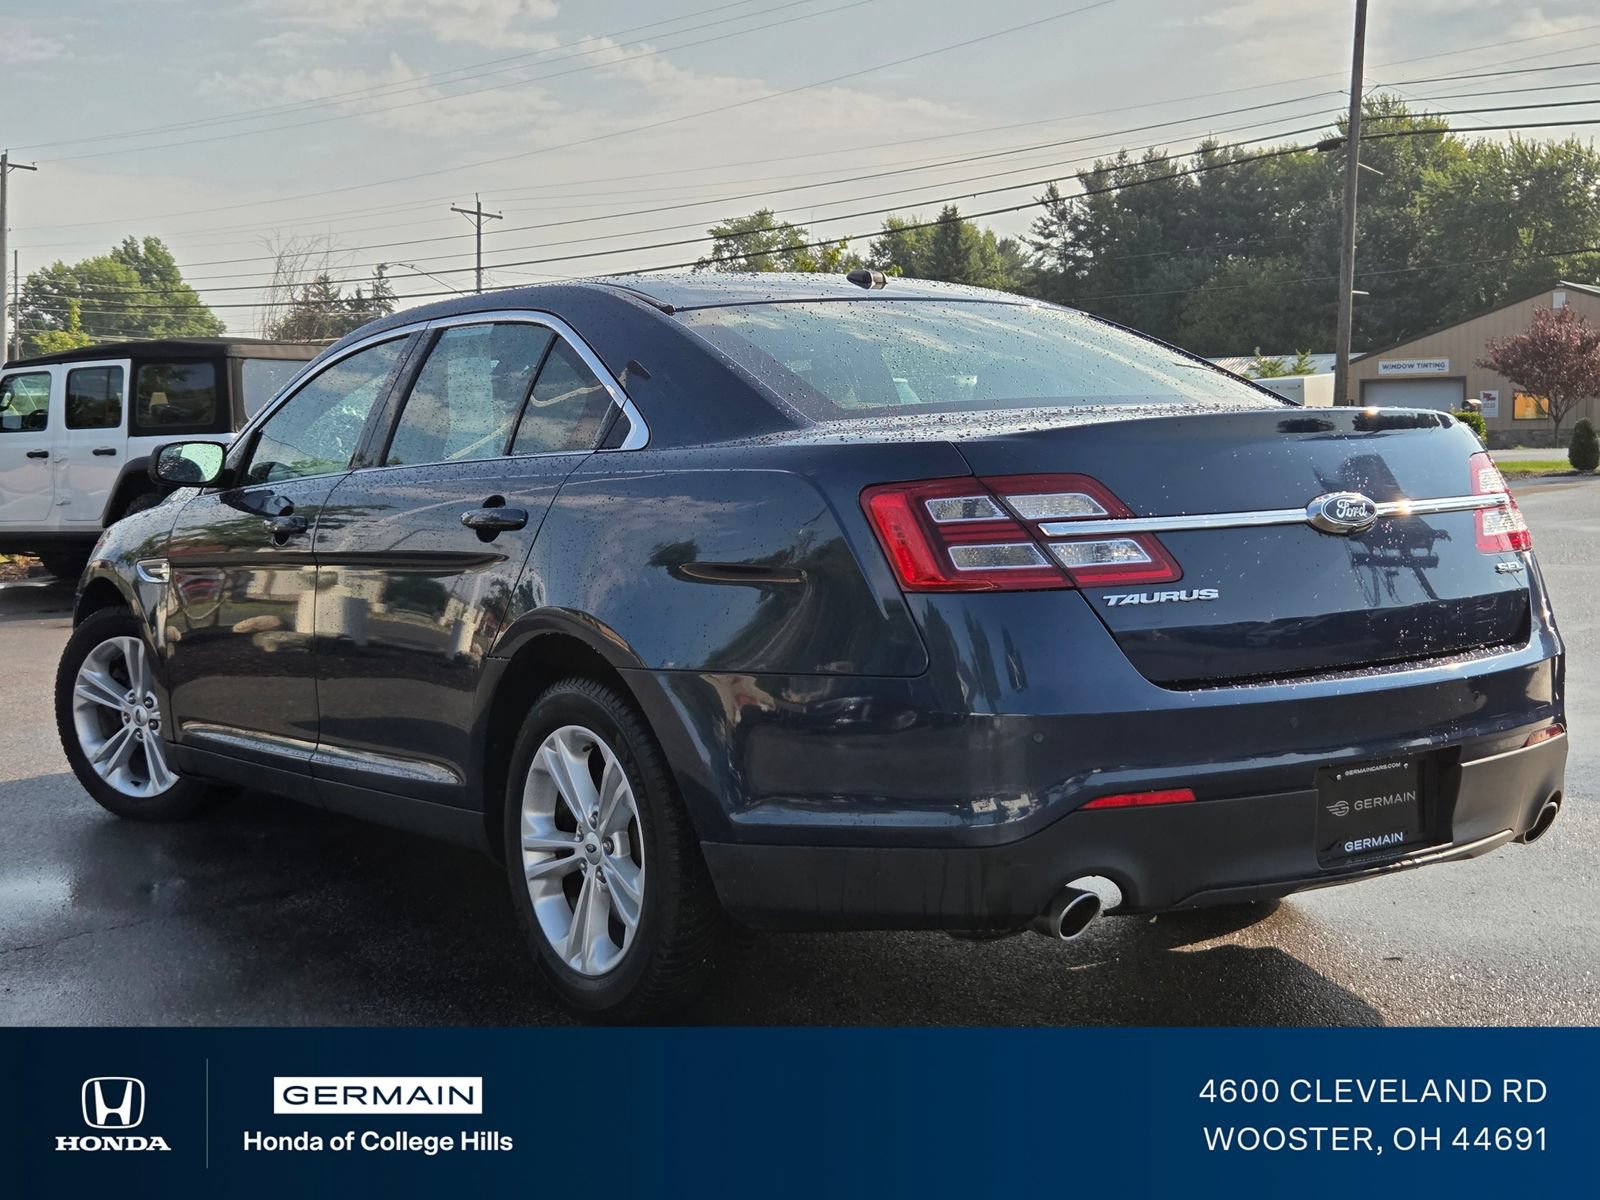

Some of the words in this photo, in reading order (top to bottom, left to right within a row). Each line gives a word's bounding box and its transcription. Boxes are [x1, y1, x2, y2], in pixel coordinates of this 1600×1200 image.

[1382, 362, 1415, 370] WINDOW
[1417, 361, 1446, 369] TINTING
[1102, 588, 1219, 607] TAURUS
[1344, 761, 1401, 777] GERMAINCARS.COM
[1353, 790, 1416, 811] GERMAIN
[1344, 831, 1404, 852] GERMAIN
